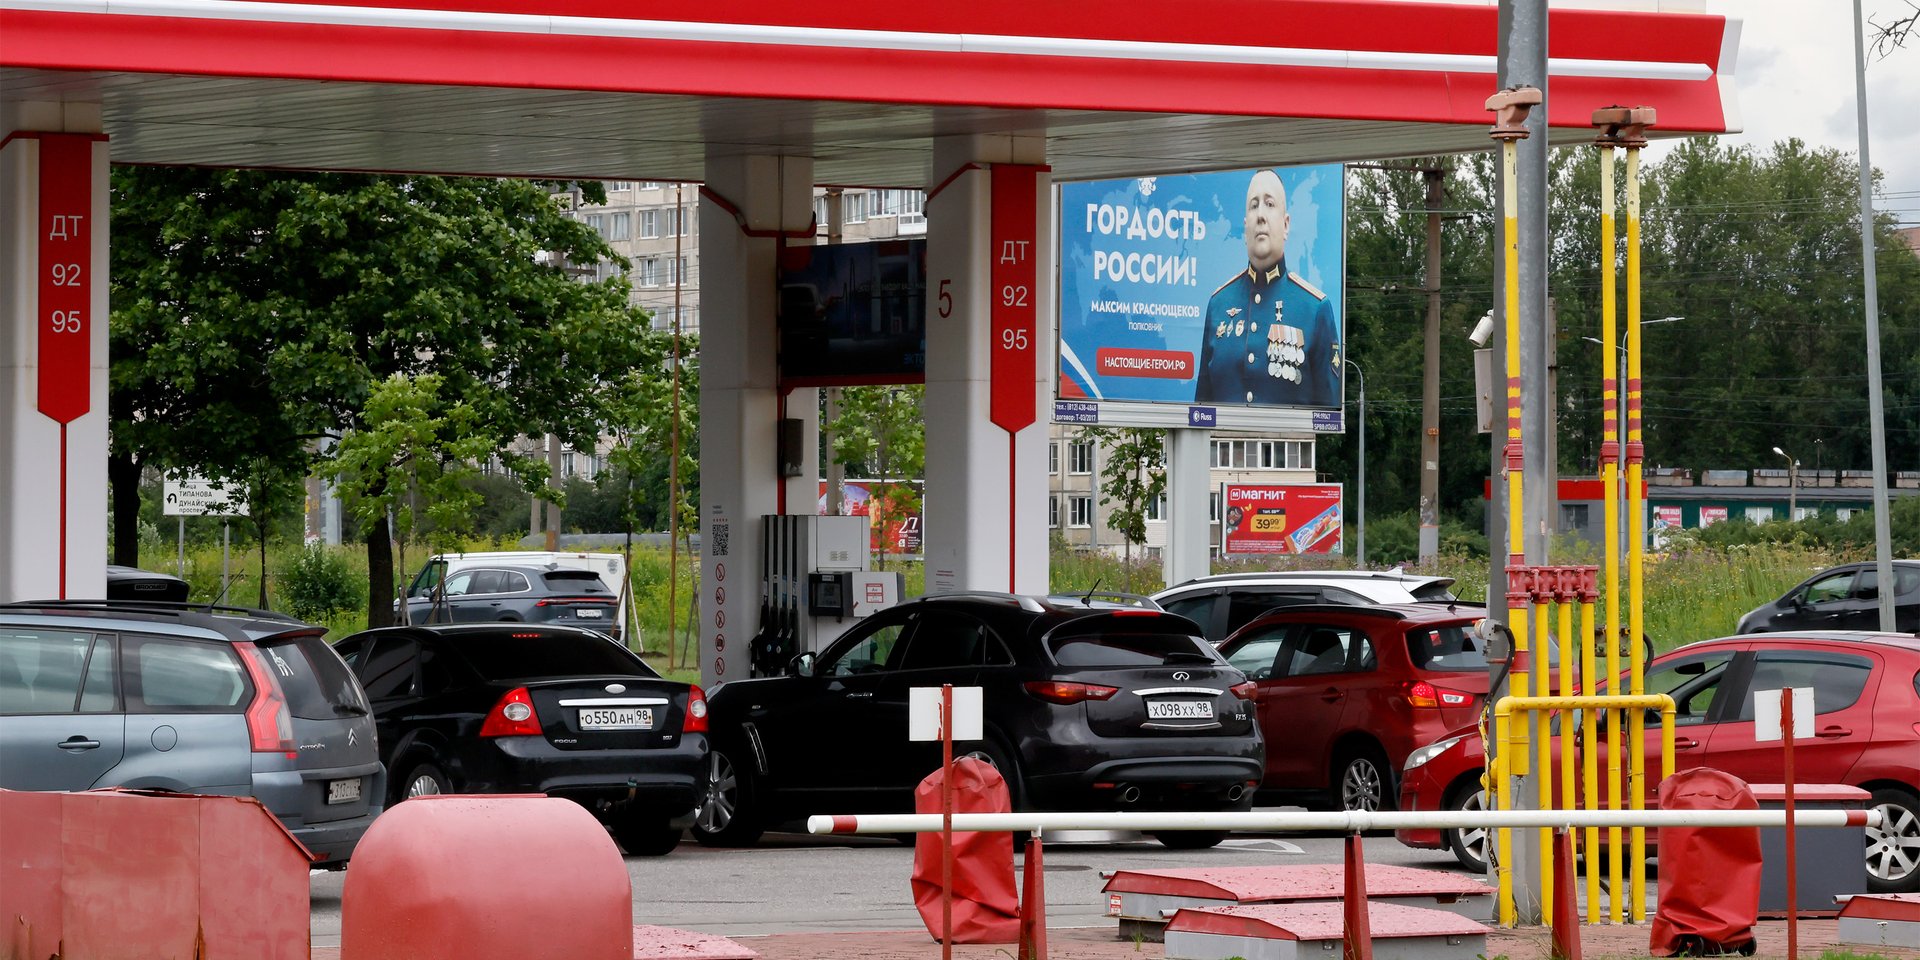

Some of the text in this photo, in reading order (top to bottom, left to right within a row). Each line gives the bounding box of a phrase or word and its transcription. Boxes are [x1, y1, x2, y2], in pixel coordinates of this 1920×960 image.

[49, 215, 83, 241] ДТ
[1086, 203, 1206, 241] ГОРДОСТЬ
[1001, 240, 1029, 264] ДТ
[52, 263, 81, 287] 92
[1094, 250, 1197, 287] РОССИИ!
[938, 279, 952, 318] 5
[1002, 285, 1028, 307] 92
[1091, 300, 1200, 318] МАКСИМ КРАСНОЩЕКОВ
[52, 310, 81, 333] 95
[1002, 328, 1028, 350] 95
[1104, 356, 1186, 371] НАСТОЯЩИЕ-ГЕРОИ.РФ
[1201, 412, 1213, 421] Russ
[636, 709, 648, 721] 98
[1197, 702, 1208, 713] 98
